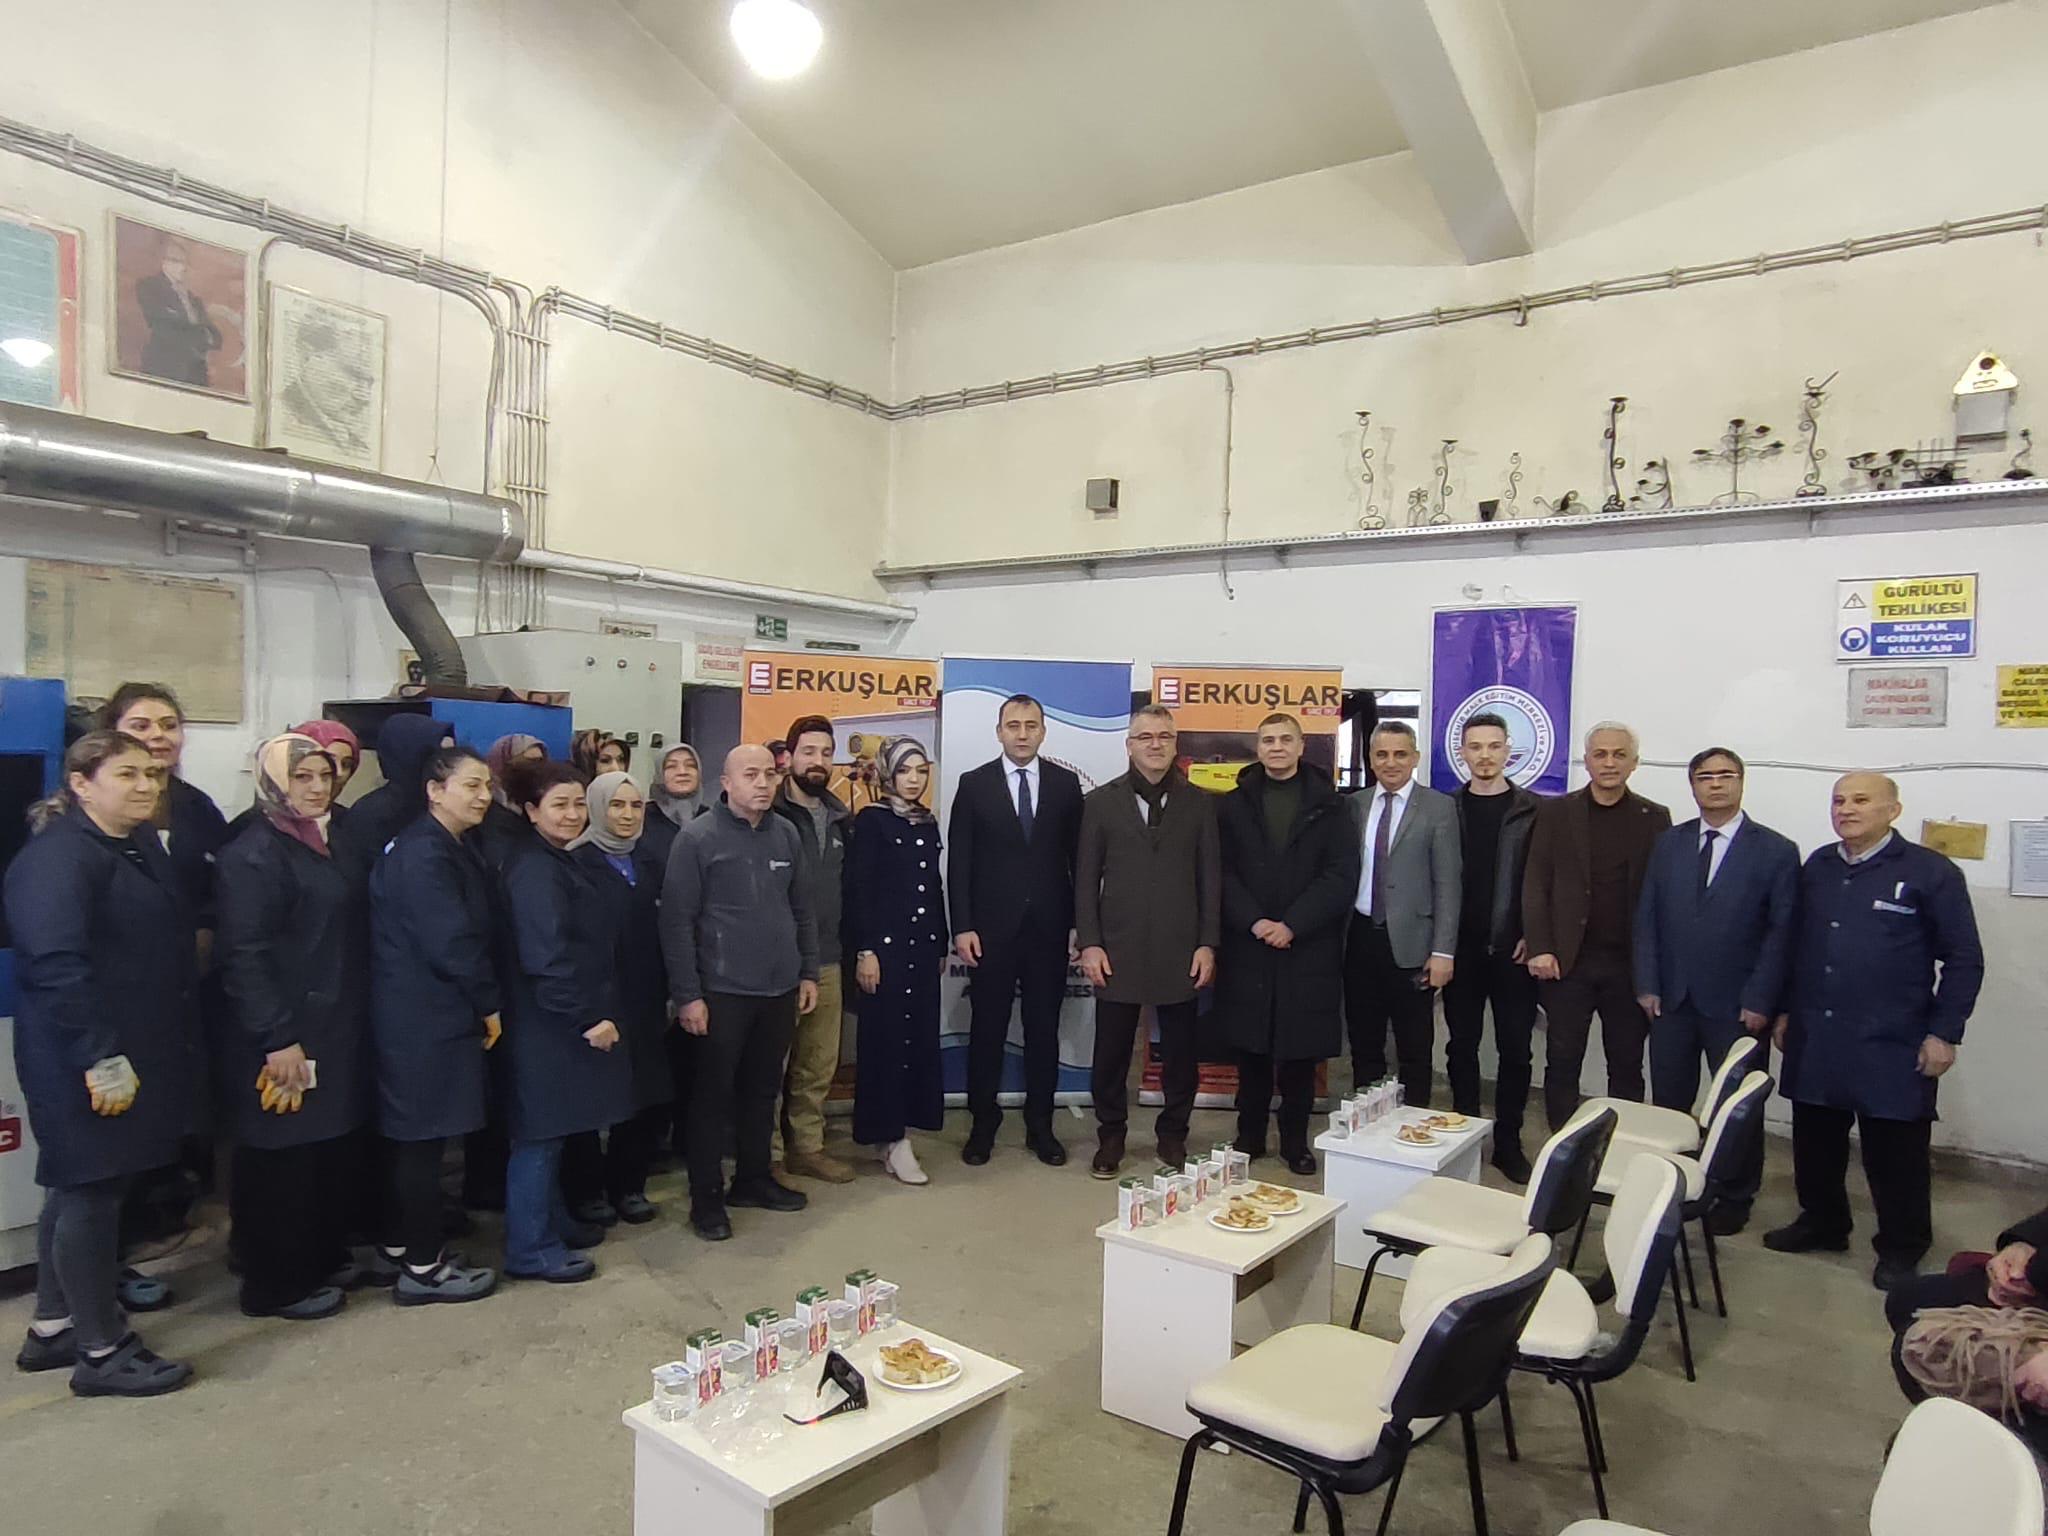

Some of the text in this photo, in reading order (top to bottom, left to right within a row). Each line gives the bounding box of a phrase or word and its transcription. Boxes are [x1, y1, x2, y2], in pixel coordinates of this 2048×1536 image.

[1883, 580, 1963, 598] GÜRÜLTÜ
[1878, 599, 1967, 617] TEHLİKESİ
[1893, 622, 1949, 632] KULAK
[1875, 633, 1967, 644] KORUYUCU
[1887, 644, 1953, 654] KULLAN
[776, 667, 933, 699] ERKUŞLAR
[1184, 682, 1340, 710] ERKUŞLAR
[1485, 692, 1516, 702] EĞİTİM
[1517, 698, 1547, 733] MERKEZİ
